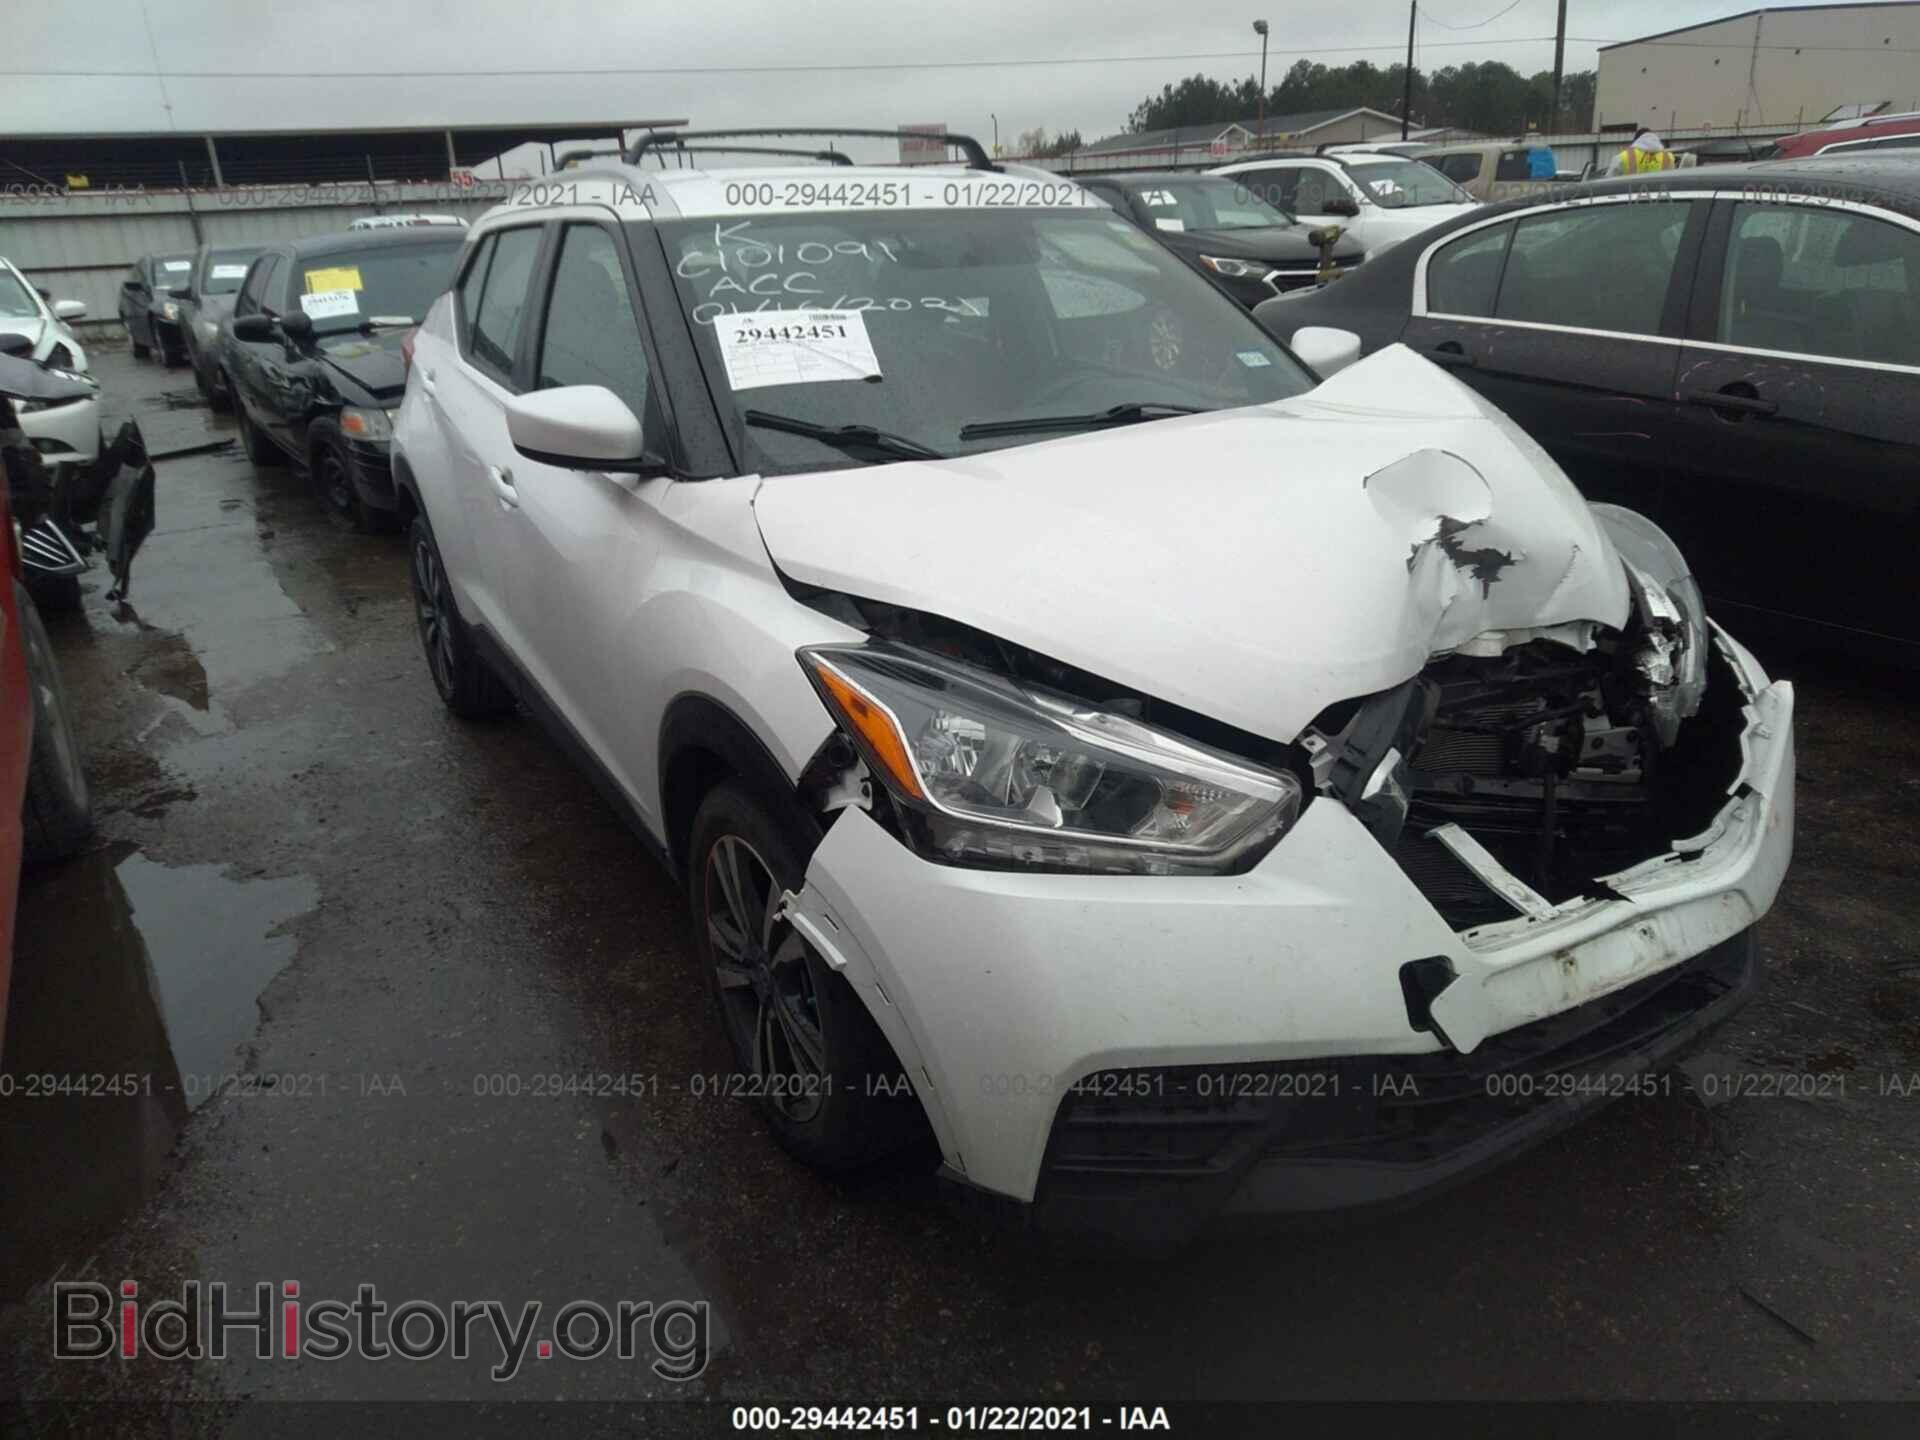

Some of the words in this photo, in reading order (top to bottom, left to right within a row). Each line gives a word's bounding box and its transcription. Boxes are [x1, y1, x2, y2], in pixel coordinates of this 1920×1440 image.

[714, 221, 768, 247] K
[709, 272, 824, 297] ACC
[735, 325, 848, 343] 29442451
